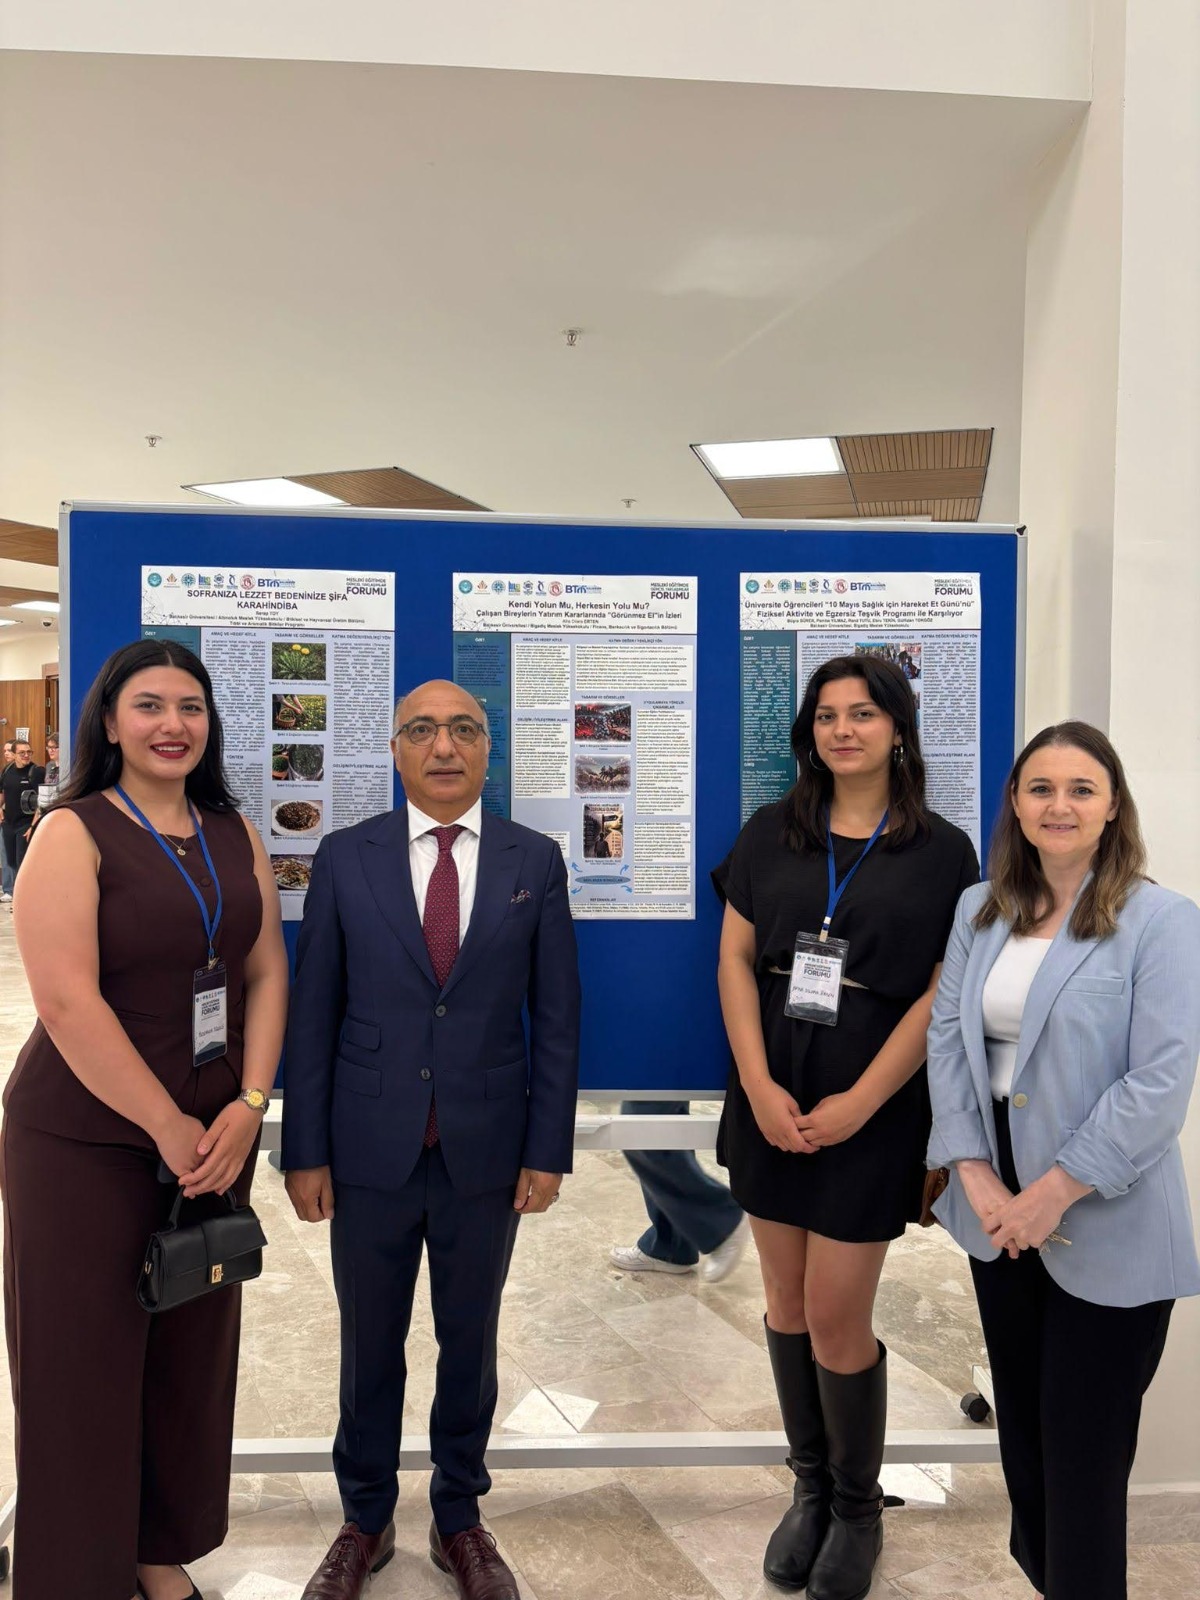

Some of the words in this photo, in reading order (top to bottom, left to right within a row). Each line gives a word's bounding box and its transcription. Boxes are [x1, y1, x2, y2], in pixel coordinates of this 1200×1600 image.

[187, 589, 238, 598] SOFRANIZA
[240, 590, 272, 600] LEZZET
[274, 590, 327, 600] BEDENİNİZE
[328, 592, 348, 602] ŞİFA
[346, 586, 387, 596] FORUMU
[651, 591, 690, 600] FORUMU
[934, 588, 973, 596] FORUMU
[237, 600, 298, 610] KARAHİNDİBA
[508, 600, 532, 608] Kendi
[534, 601, 556, 609] Yolun
[559, 602, 574, 610] Mu,
[576, 602, 610, 610] Herkesin
[613, 602, 630, 610] Yolu
[783, 600, 824, 610] Öğrencileri
[839, 601, 860, 610] Mayıs
[862, 600, 884, 610] Sağlık
[886, 601, 900, 610] için
[476, 610, 502, 618] Çalışan
[504, 610, 536, 618] Bireylerin
[756, 610, 784, 618] Fiziksel
[826, 610, 856, 619] Egzersiz
[858, 610, 880, 618] Teşvik
[882, 610, 916, 619] Programı
[917, 610, 926, 618] ile
[928, 610, 963, 619] Karşılıyor
[804, 968, 831, 978] FORUMU
[202, 1004, 220, 1016] FORUMU
